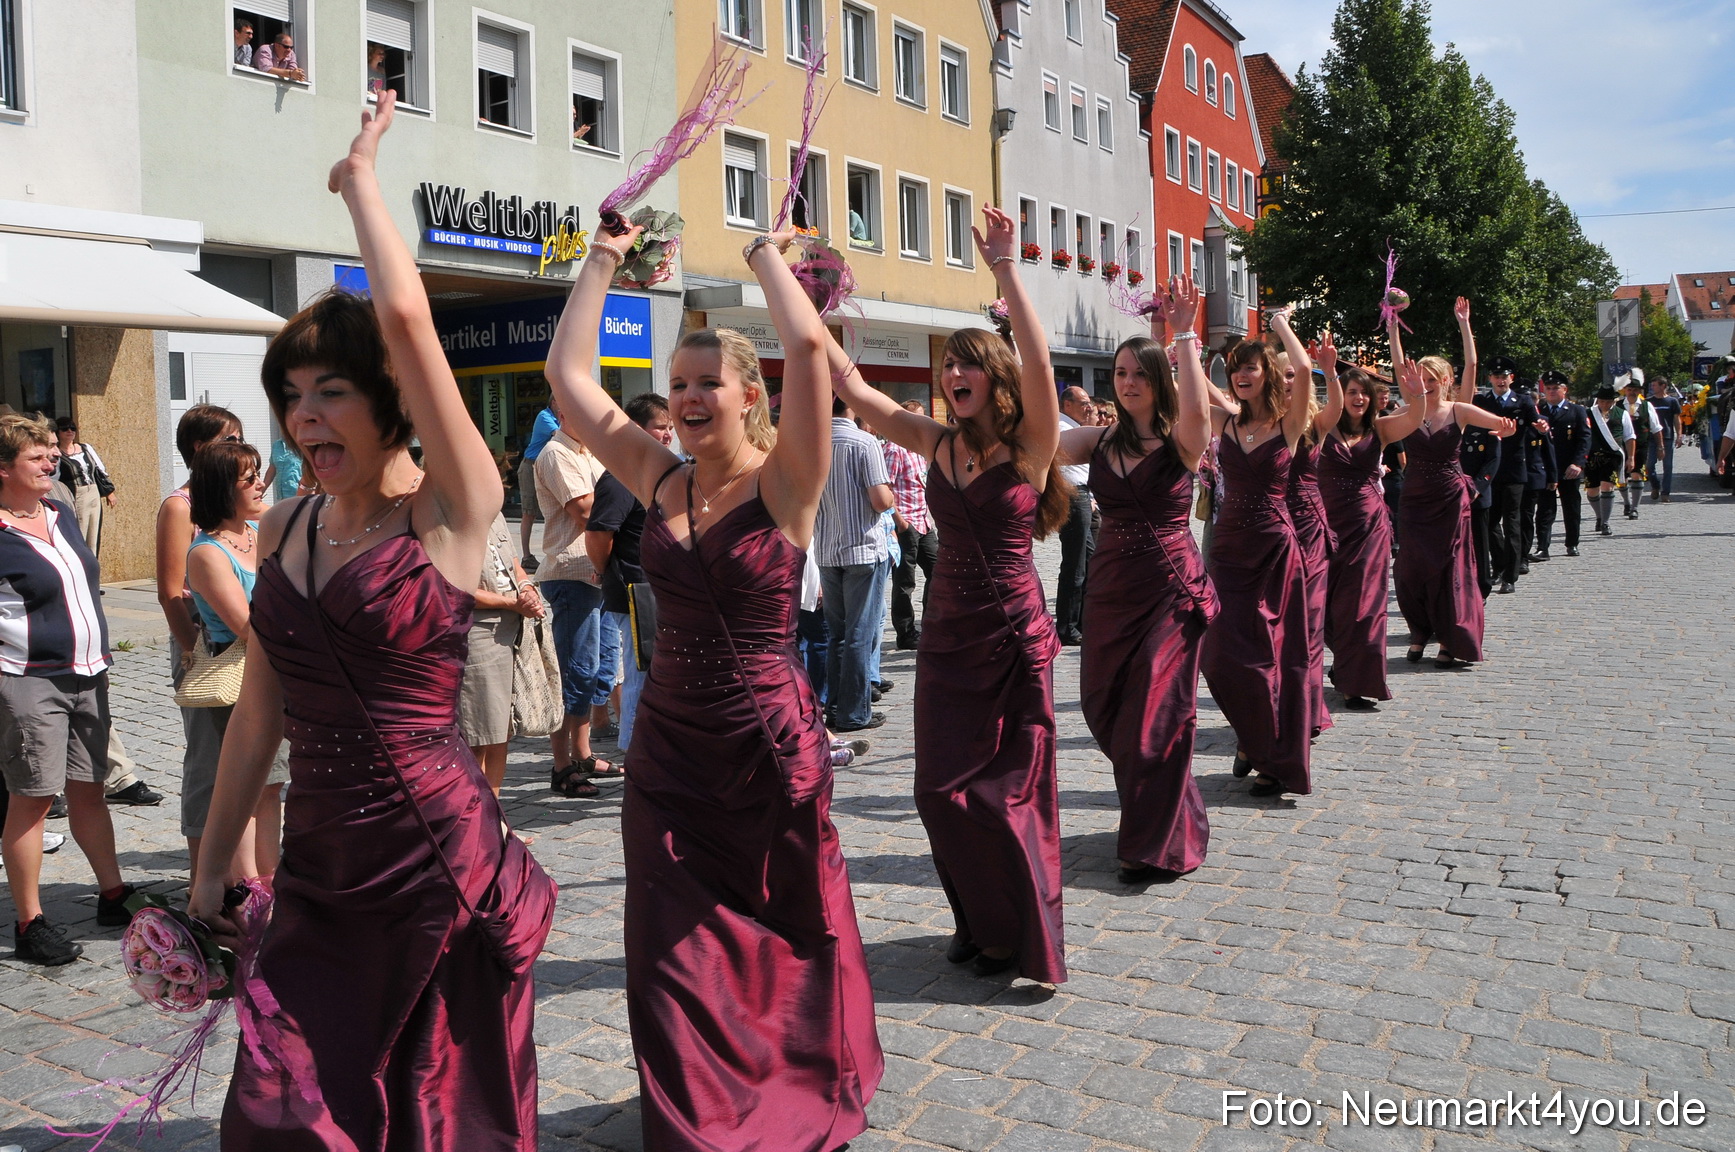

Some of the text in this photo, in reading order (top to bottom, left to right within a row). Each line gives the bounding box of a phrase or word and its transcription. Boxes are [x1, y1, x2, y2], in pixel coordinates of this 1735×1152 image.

[420, 181, 580, 241] Weltbild
[434, 231, 533, 254] BÜCHER MUSIK VIDEOS
[539, 224, 589, 276] plus
[436, 322, 496, 351] artikel
[605, 316, 643, 336] Bücher
[750, 326, 767, 336] Optik
[887, 338, 900, 348] Optik
[887, 351, 909, 359] CENTRUM
[489, 379, 500, 436] Weltbild
